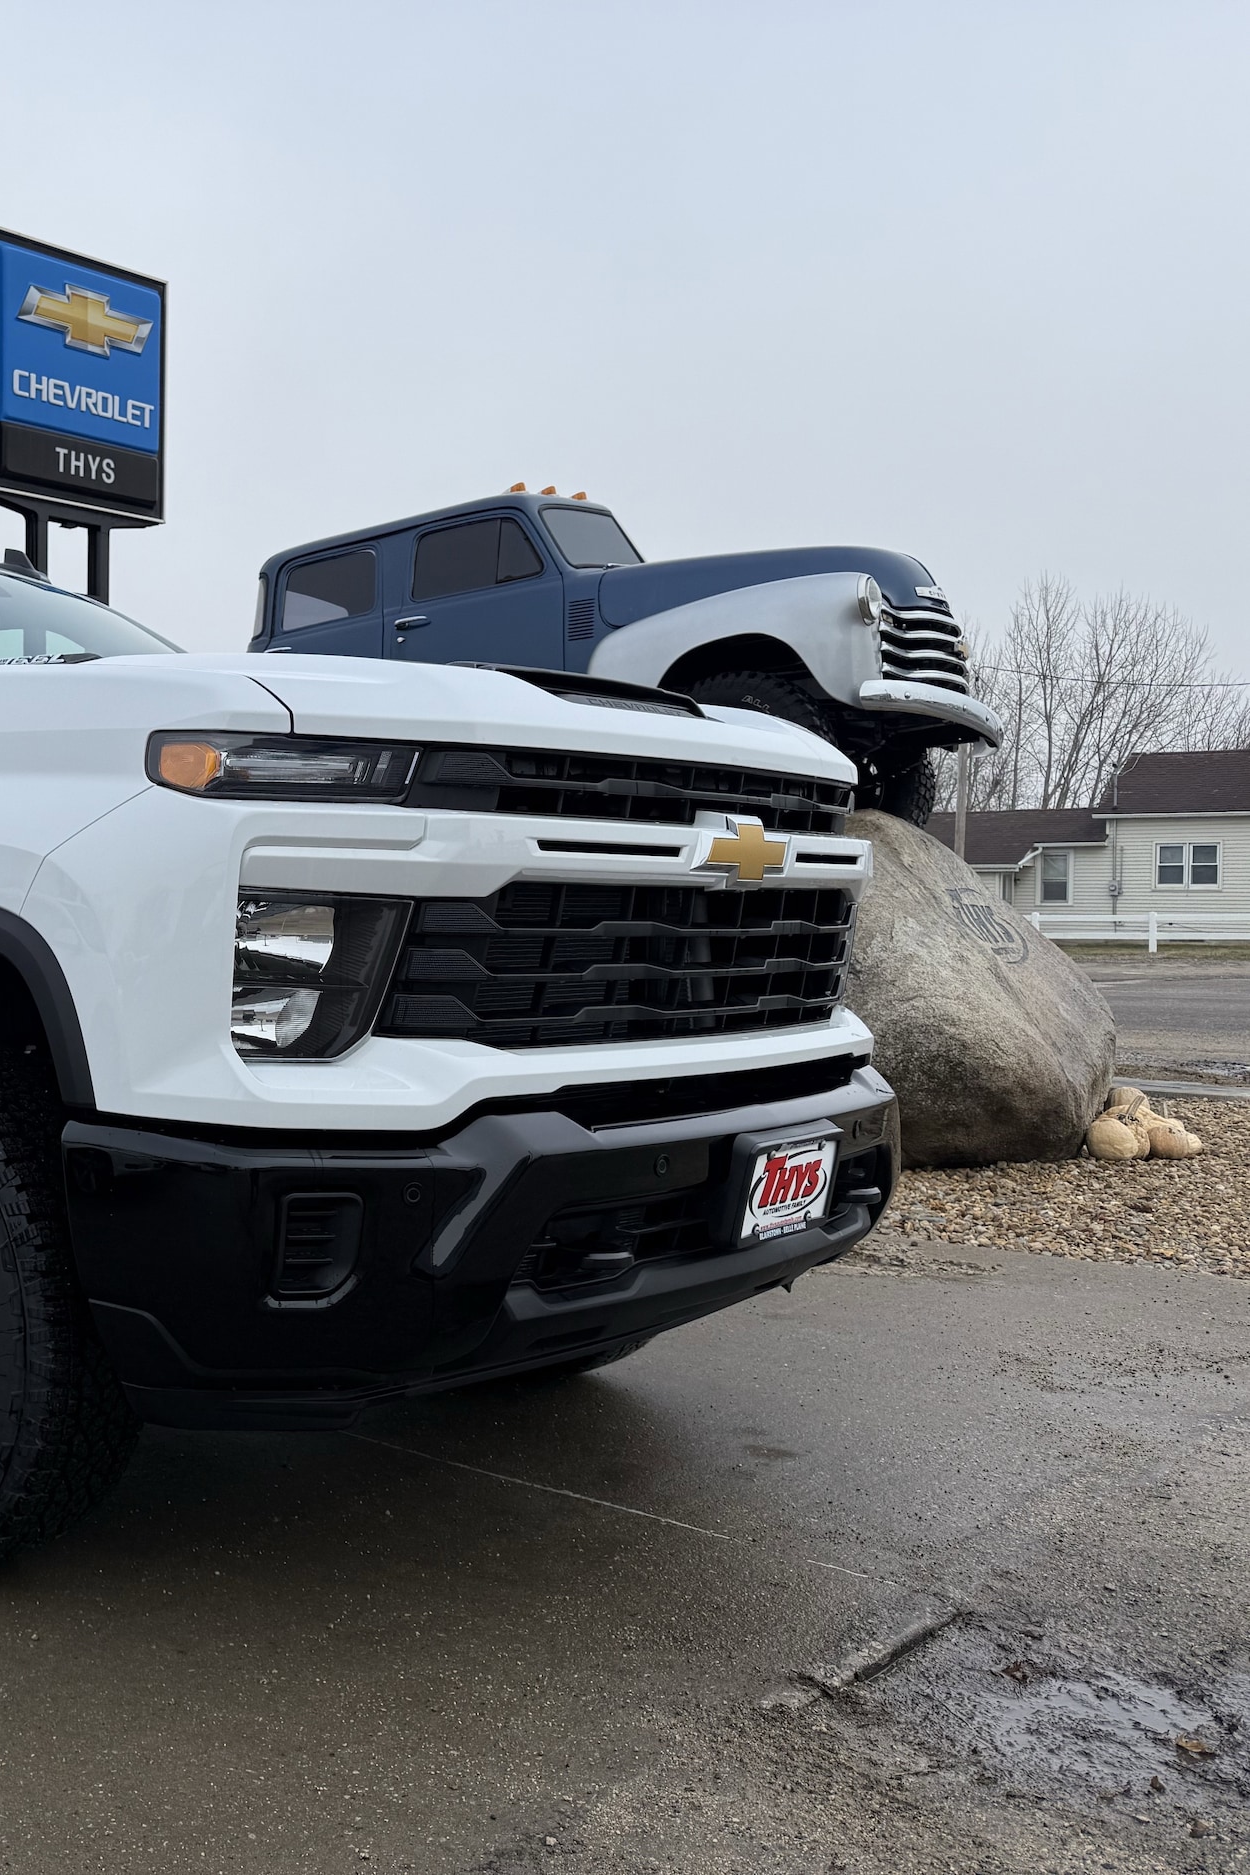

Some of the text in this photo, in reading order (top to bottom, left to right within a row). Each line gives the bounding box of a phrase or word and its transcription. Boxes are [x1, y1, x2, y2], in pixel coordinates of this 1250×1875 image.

[12, 368, 155, 429] CHEVROLET
[54, 447, 116, 484] THYS
[586, 697, 682, 717] CHEVROLET
[757, 1154, 823, 1209] THYS
[762, 1200, 806, 1216] AUTOMOTIVE FAMILY
